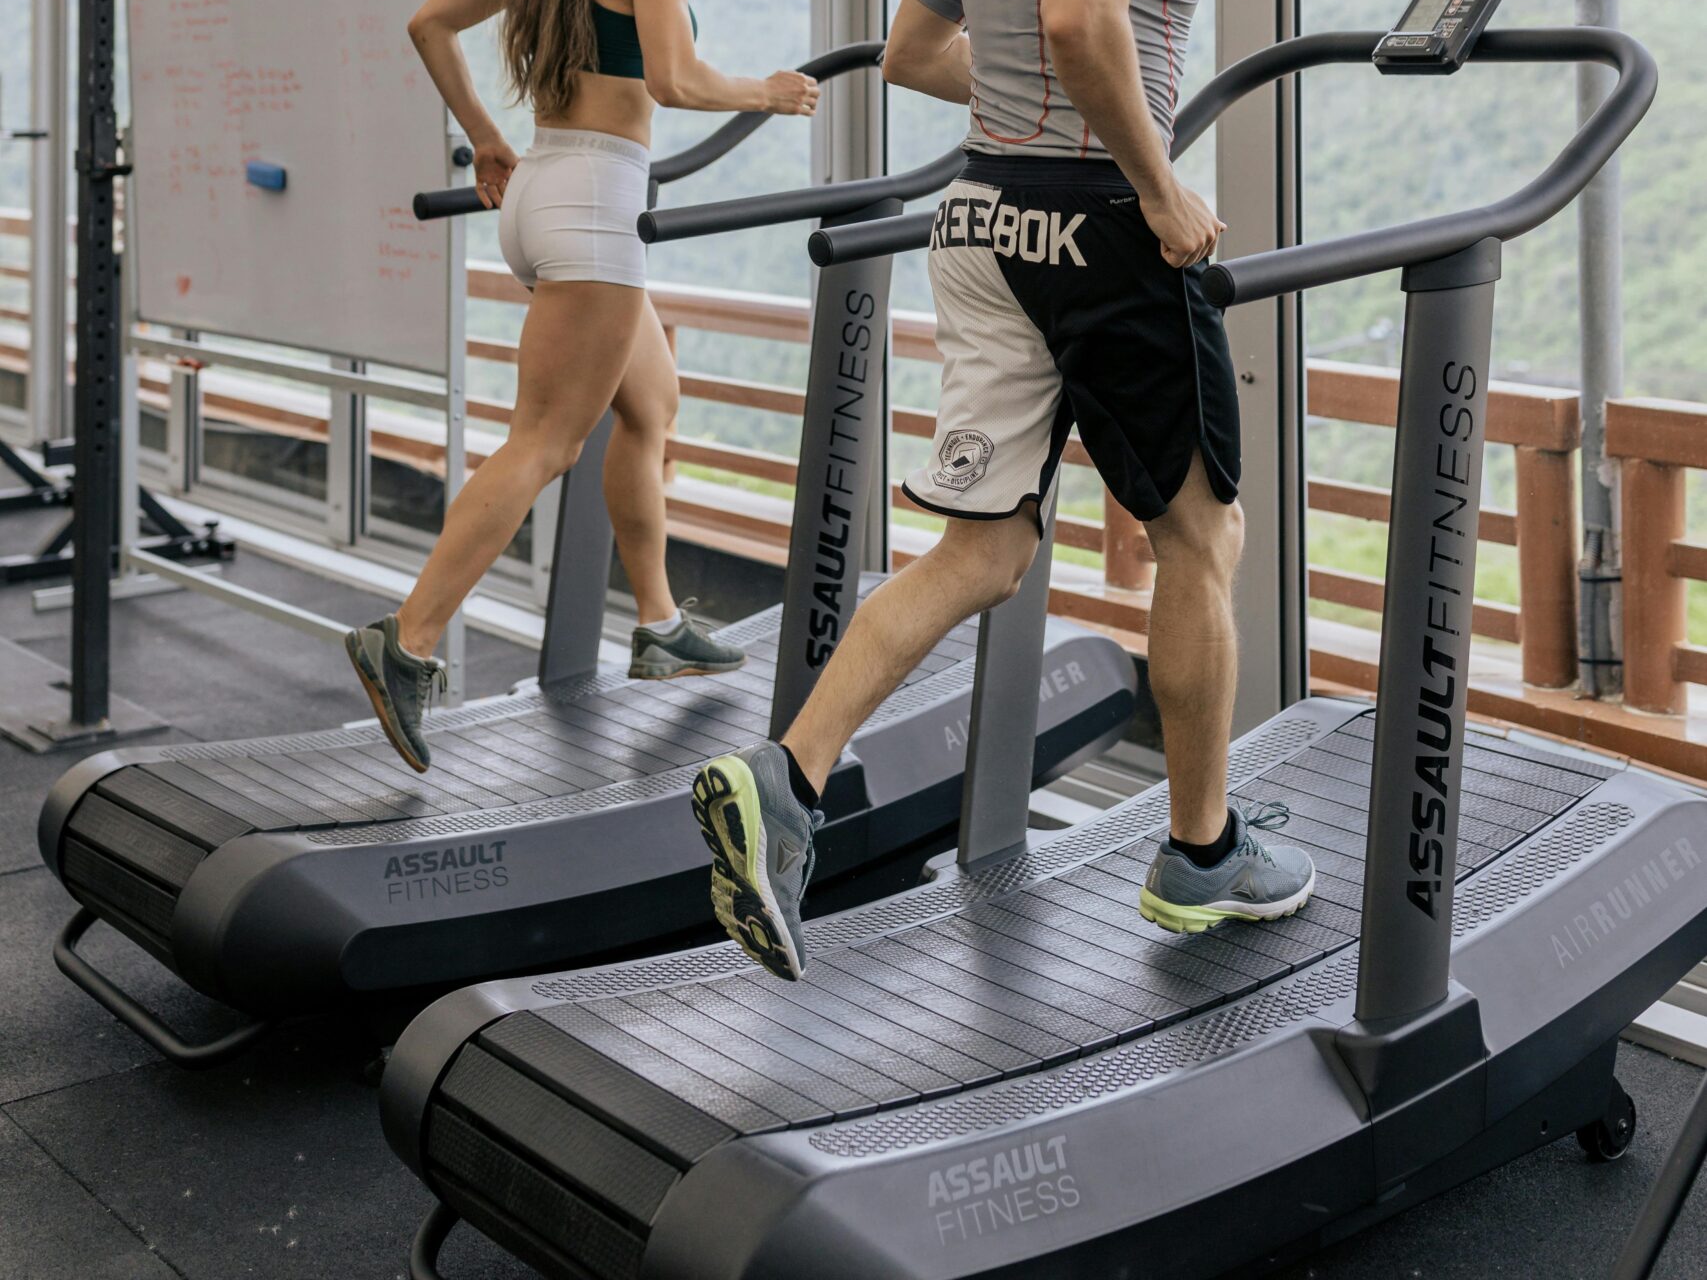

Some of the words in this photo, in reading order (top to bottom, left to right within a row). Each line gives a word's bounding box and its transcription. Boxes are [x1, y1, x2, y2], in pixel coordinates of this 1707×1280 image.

[931, 197, 1088, 267] REEBOK
[805, 290, 875, 671] SSAULTFITNESS
[950, 470, 979, 485] DISCIPLINE
[384, 840, 507, 879] ASSAULT
[387, 866, 510, 904] FITNESS
[928, 1135, 1067, 1208] ASSAULT
[935, 1174, 1080, 1246] FITNESS
